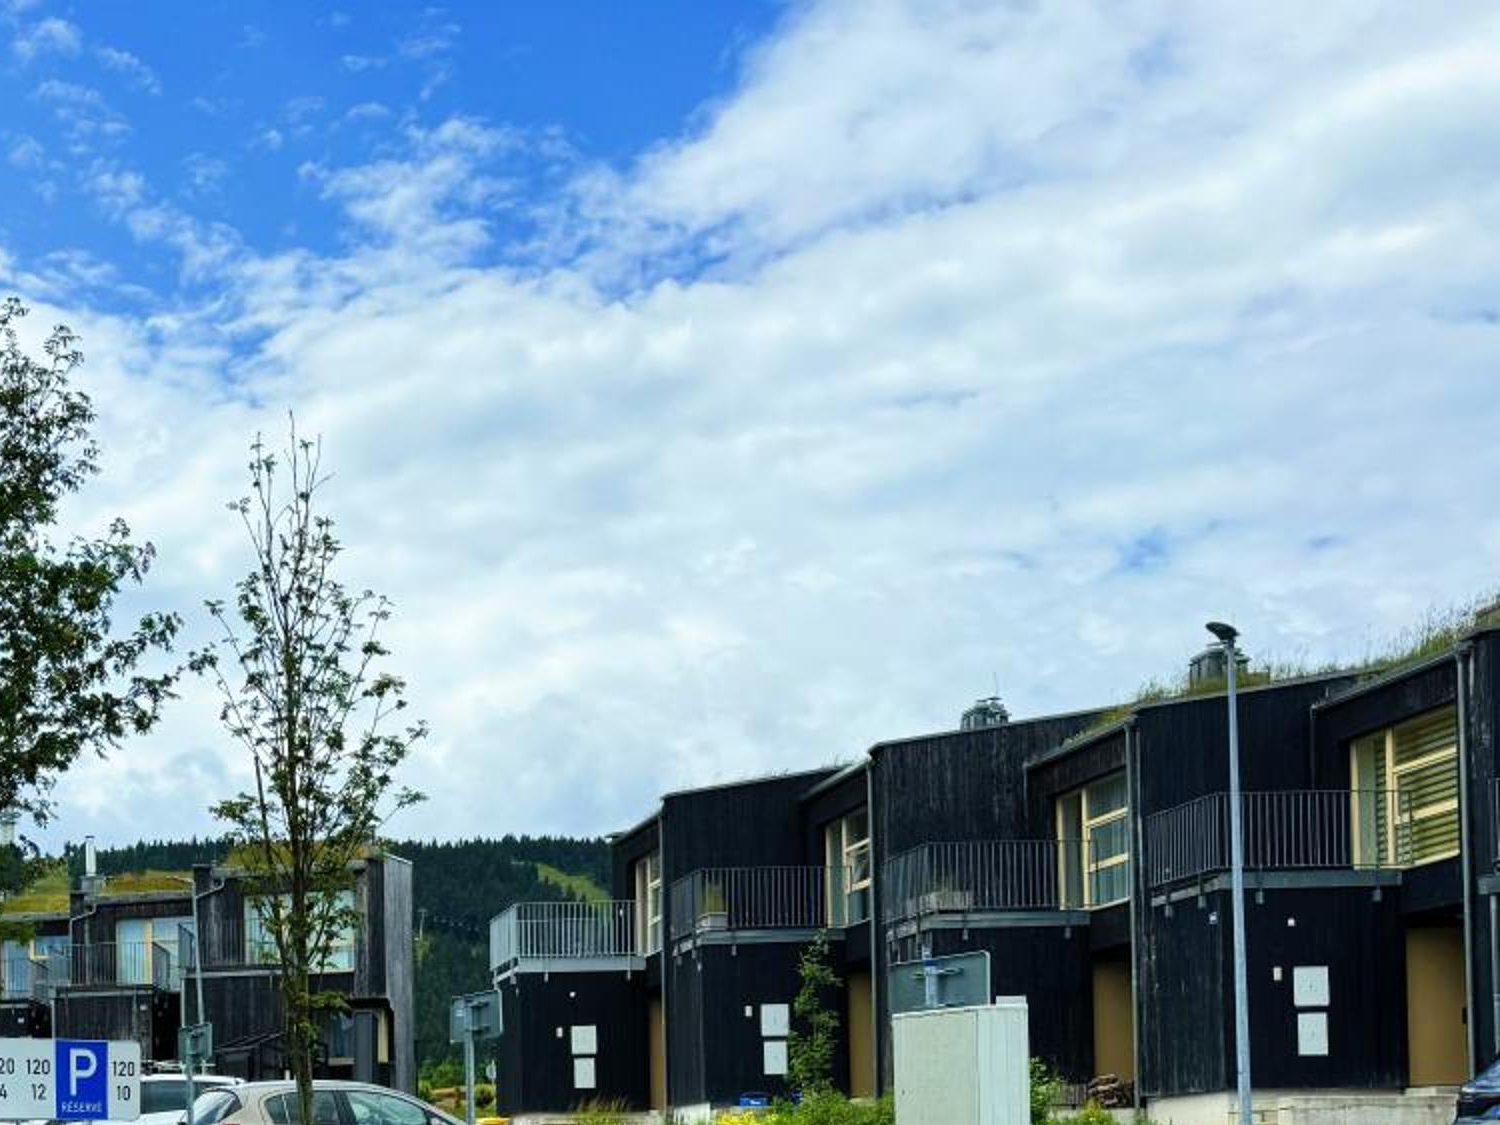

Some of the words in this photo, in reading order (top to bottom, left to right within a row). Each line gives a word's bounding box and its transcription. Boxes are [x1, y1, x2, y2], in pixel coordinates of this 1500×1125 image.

[26, 1058, 51, 1075] 120
[69, 1048, 98, 1097] P
[112, 1061, 135, 1077] 120
[0, 1083, 8, 1100] 4
[31, 1083, 47, 1101] 12
[116, 1085, 132, 1101] 10
